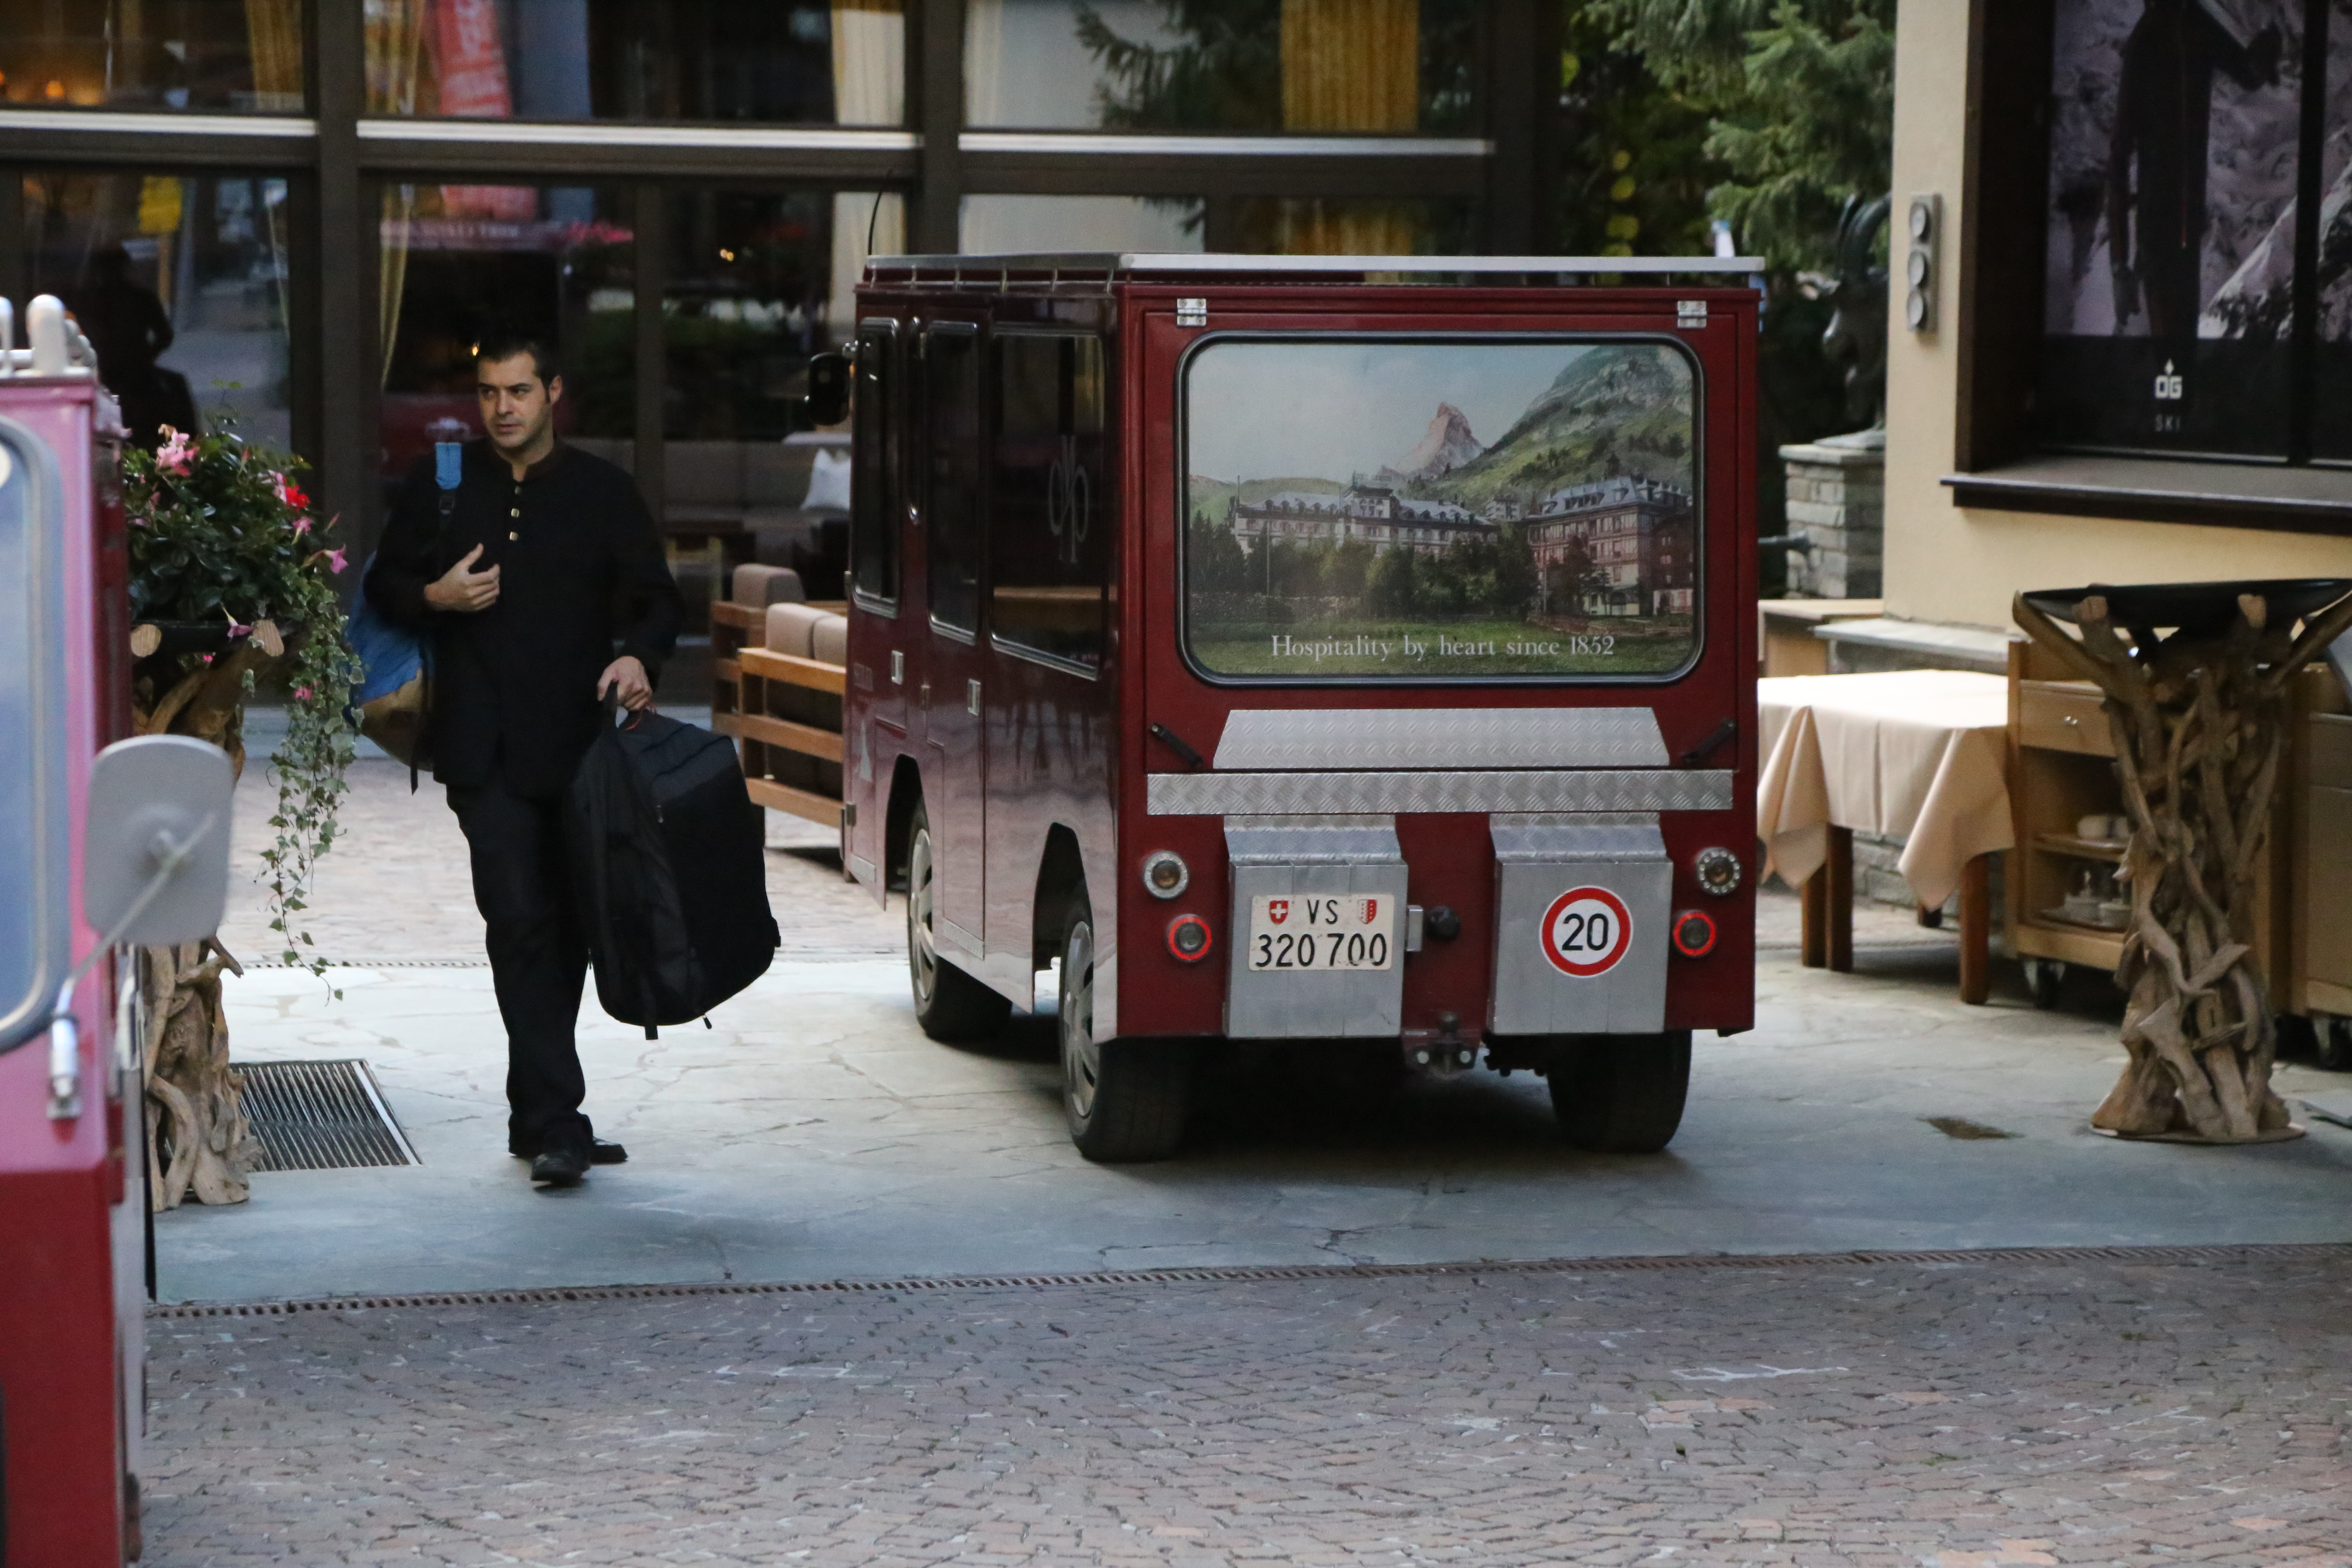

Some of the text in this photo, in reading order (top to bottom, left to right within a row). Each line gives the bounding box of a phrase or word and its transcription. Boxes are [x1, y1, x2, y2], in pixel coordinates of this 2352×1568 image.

[1271, 634, 1614, 662] Hospitality by heart since 1852
[1307, 899, 1338, 925] VS
[1562, 913, 1609, 951] 20
